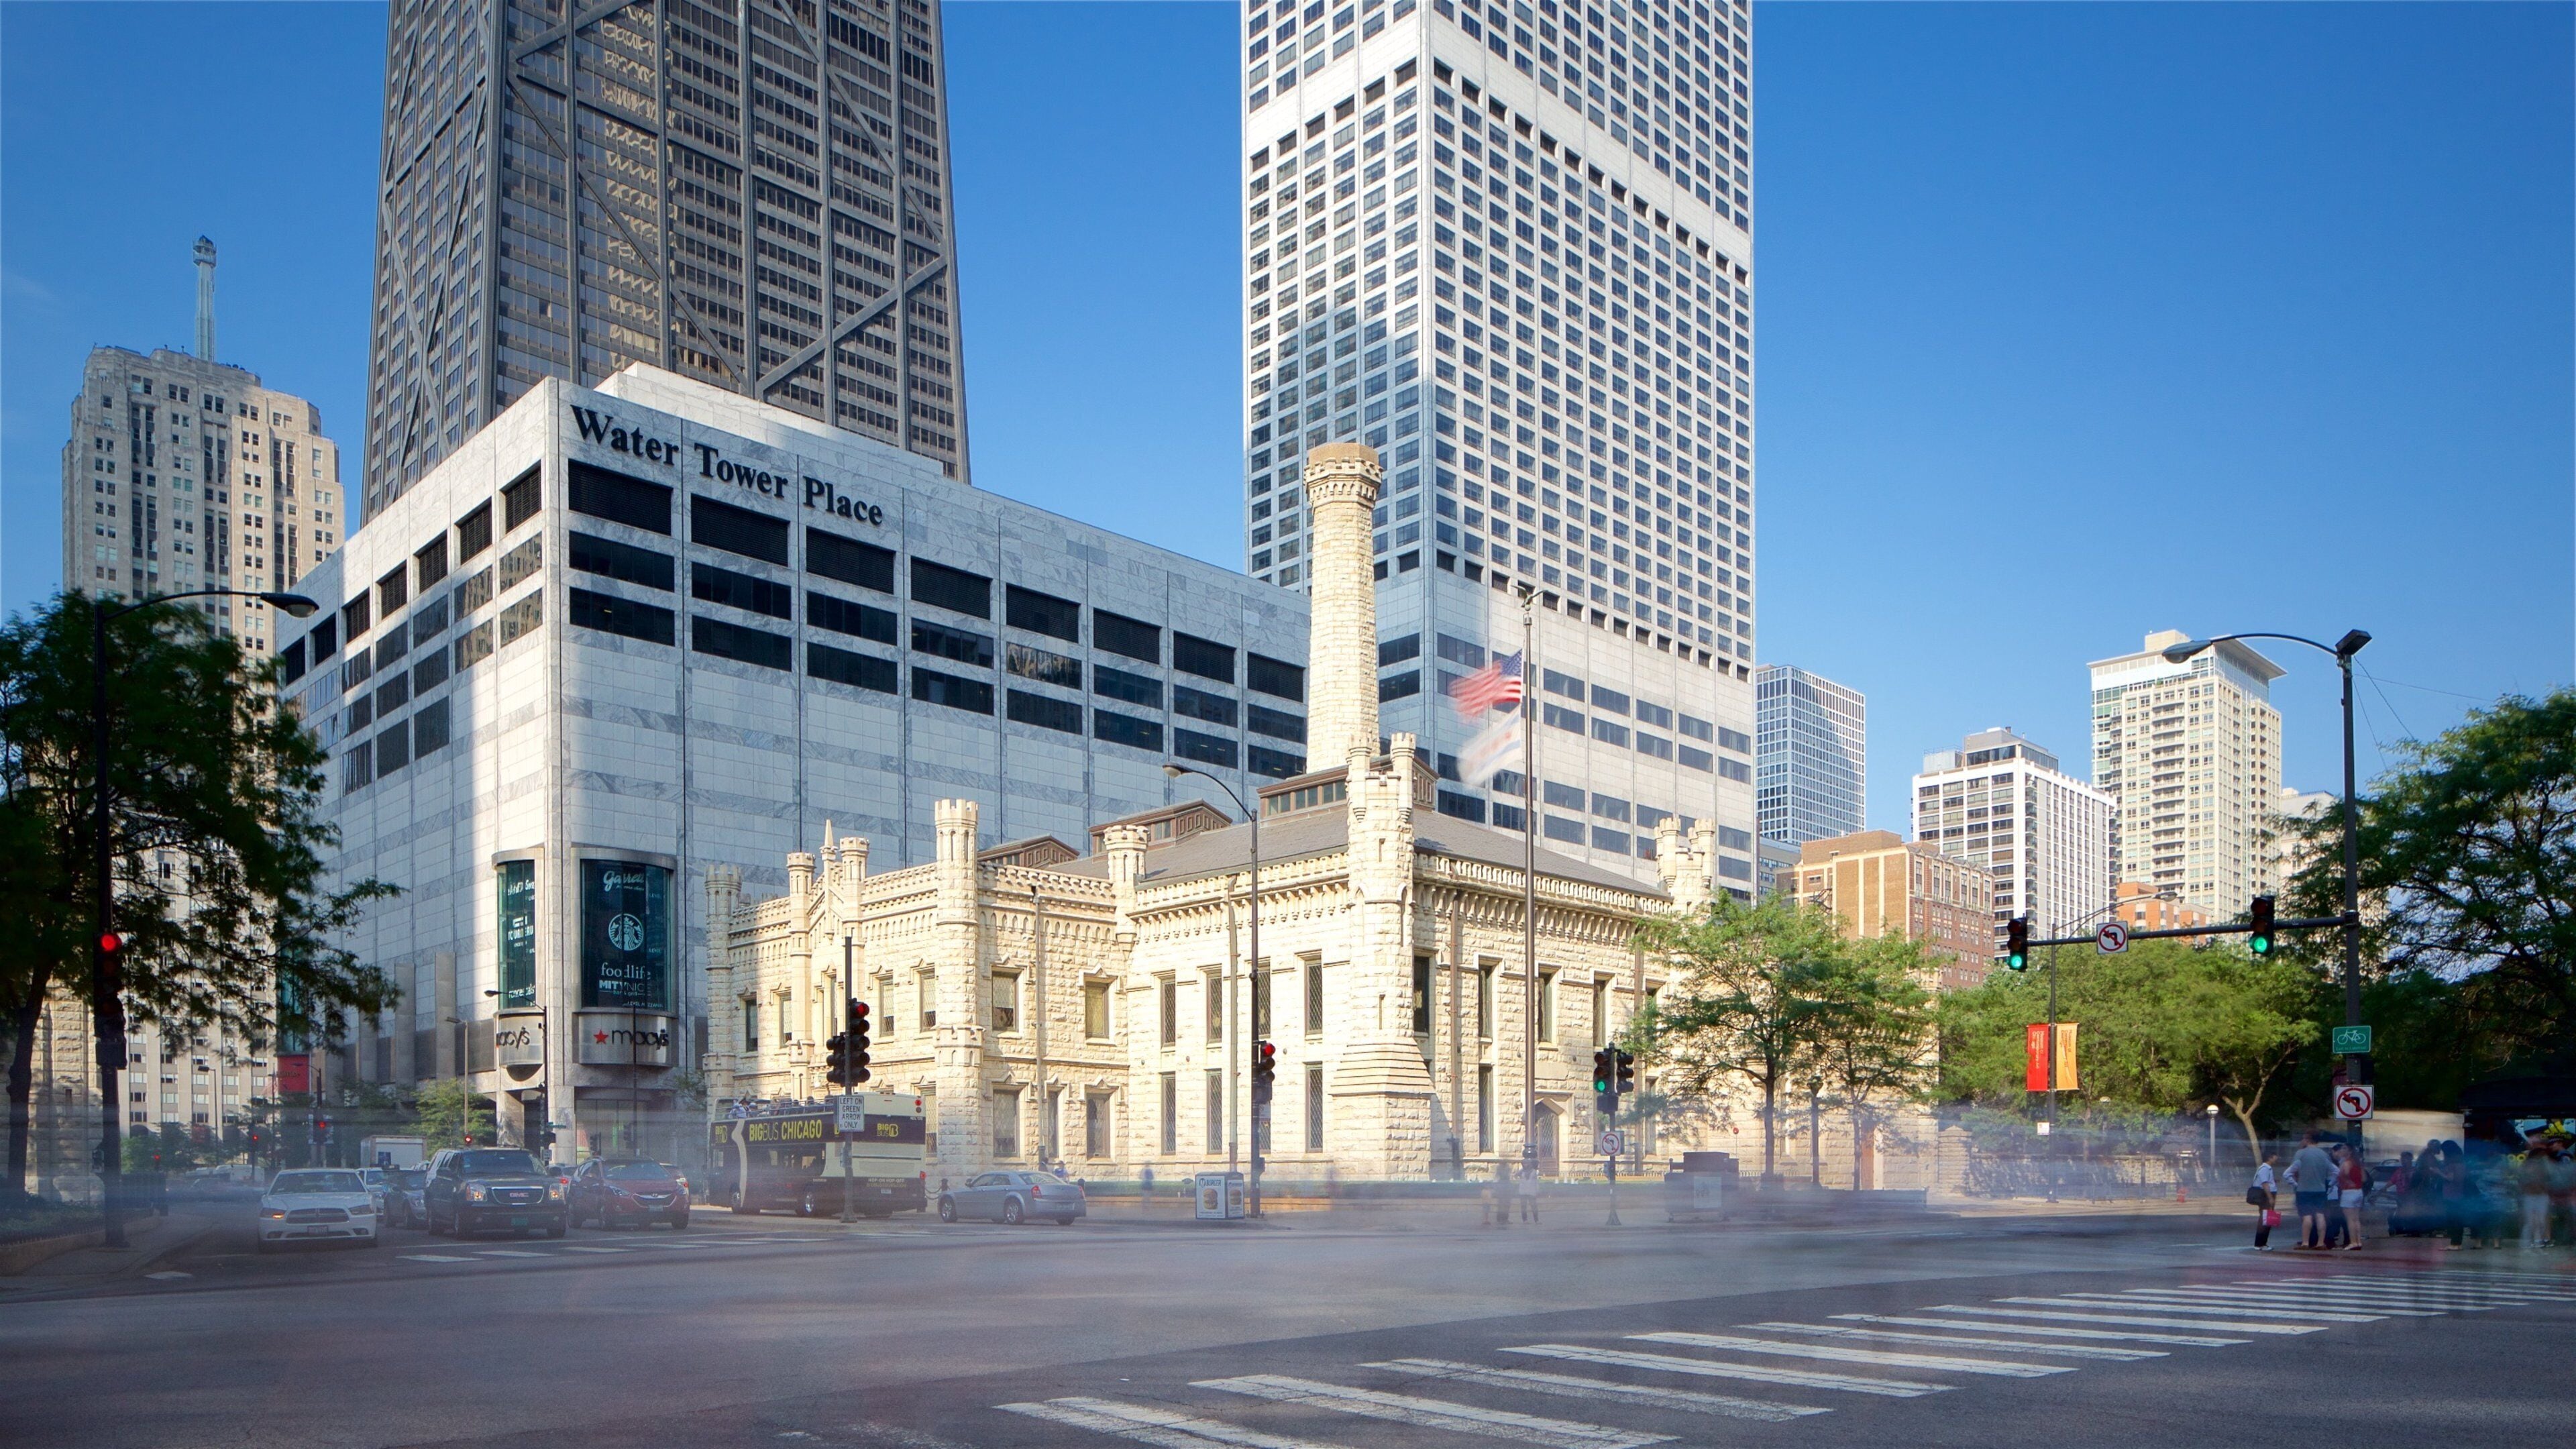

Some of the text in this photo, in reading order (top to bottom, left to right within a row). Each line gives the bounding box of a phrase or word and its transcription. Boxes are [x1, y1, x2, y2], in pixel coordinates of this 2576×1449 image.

[570, 405, 883, 526] Water Tower Place
[611, 1028, 669, 1051] macy's
[781, 1119, 822, 1140] CHICAGO
